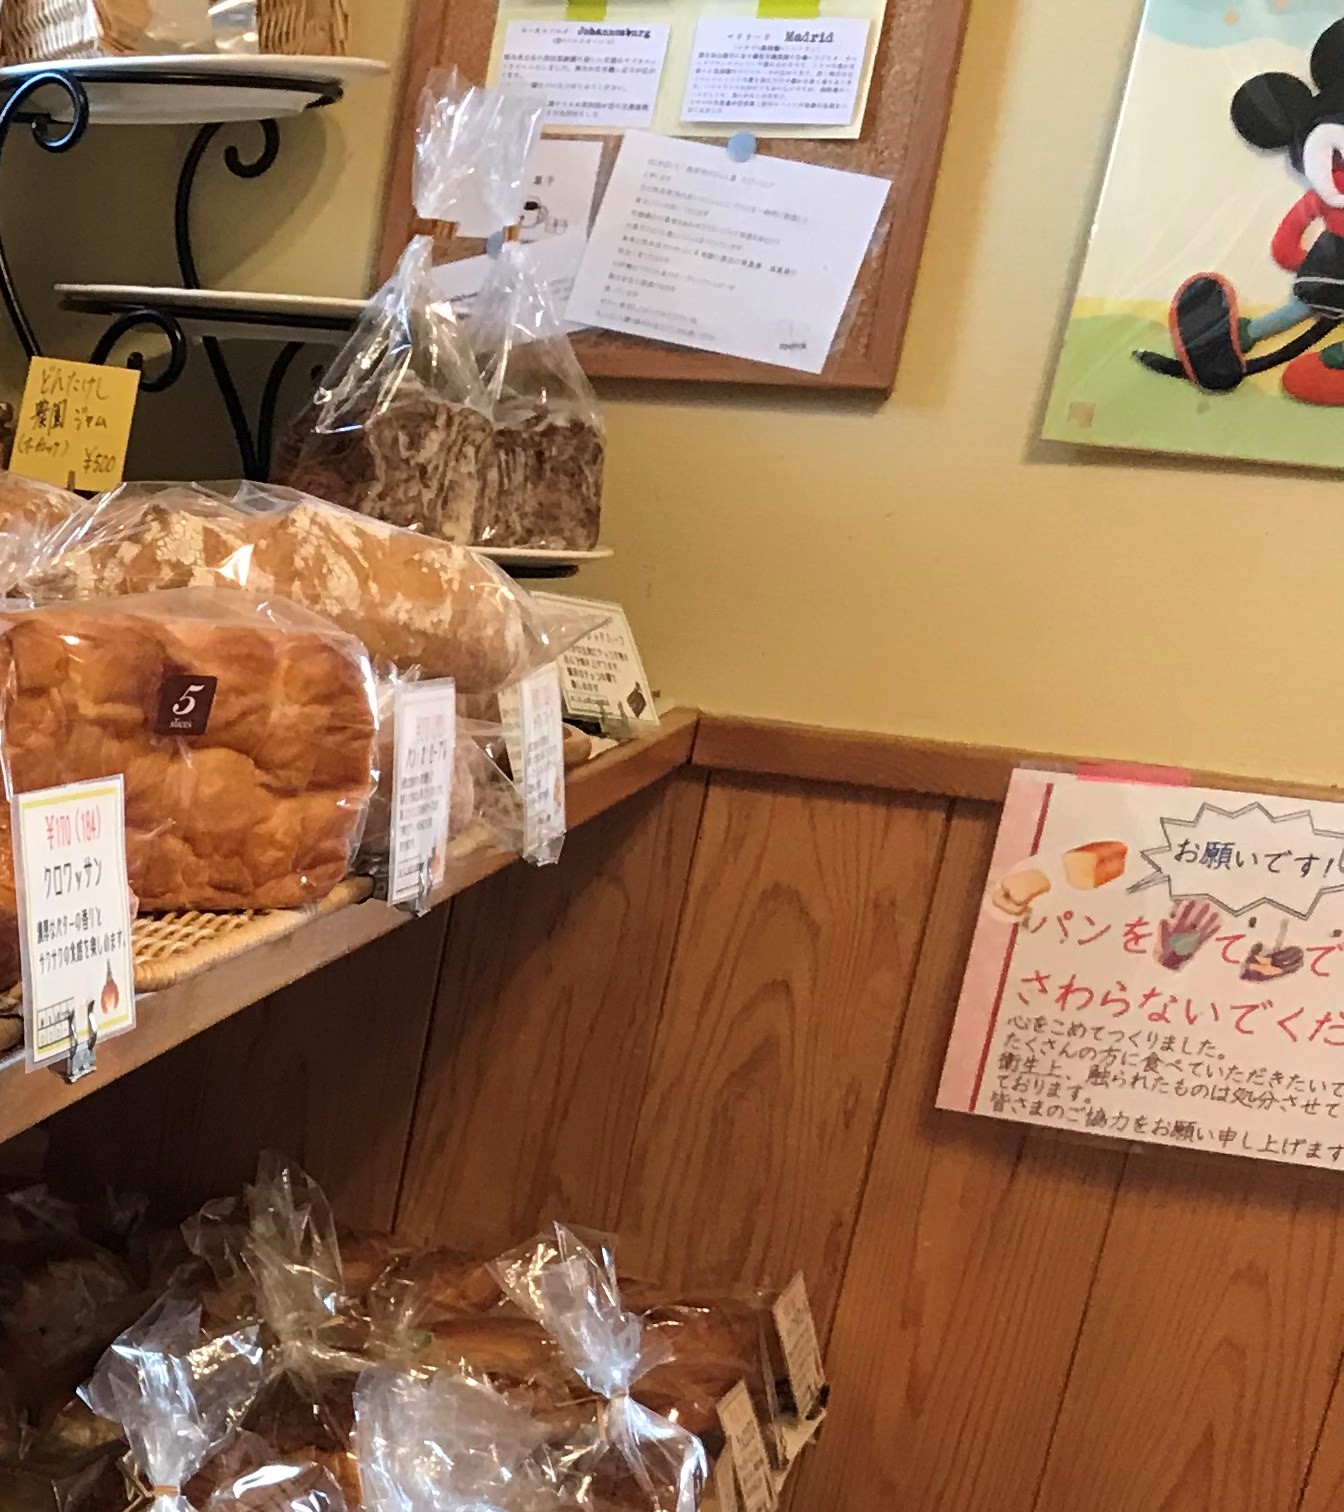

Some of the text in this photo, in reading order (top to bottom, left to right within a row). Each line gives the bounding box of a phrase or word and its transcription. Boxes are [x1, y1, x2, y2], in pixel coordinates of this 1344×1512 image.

[784, 30, 835, 43] Madrid
[172, 683, 205, 715] 5
[1173, 836, 1336, 879] お願いです!
[1007, 1015, 1226, 1061] 心をこめてつくりました。
